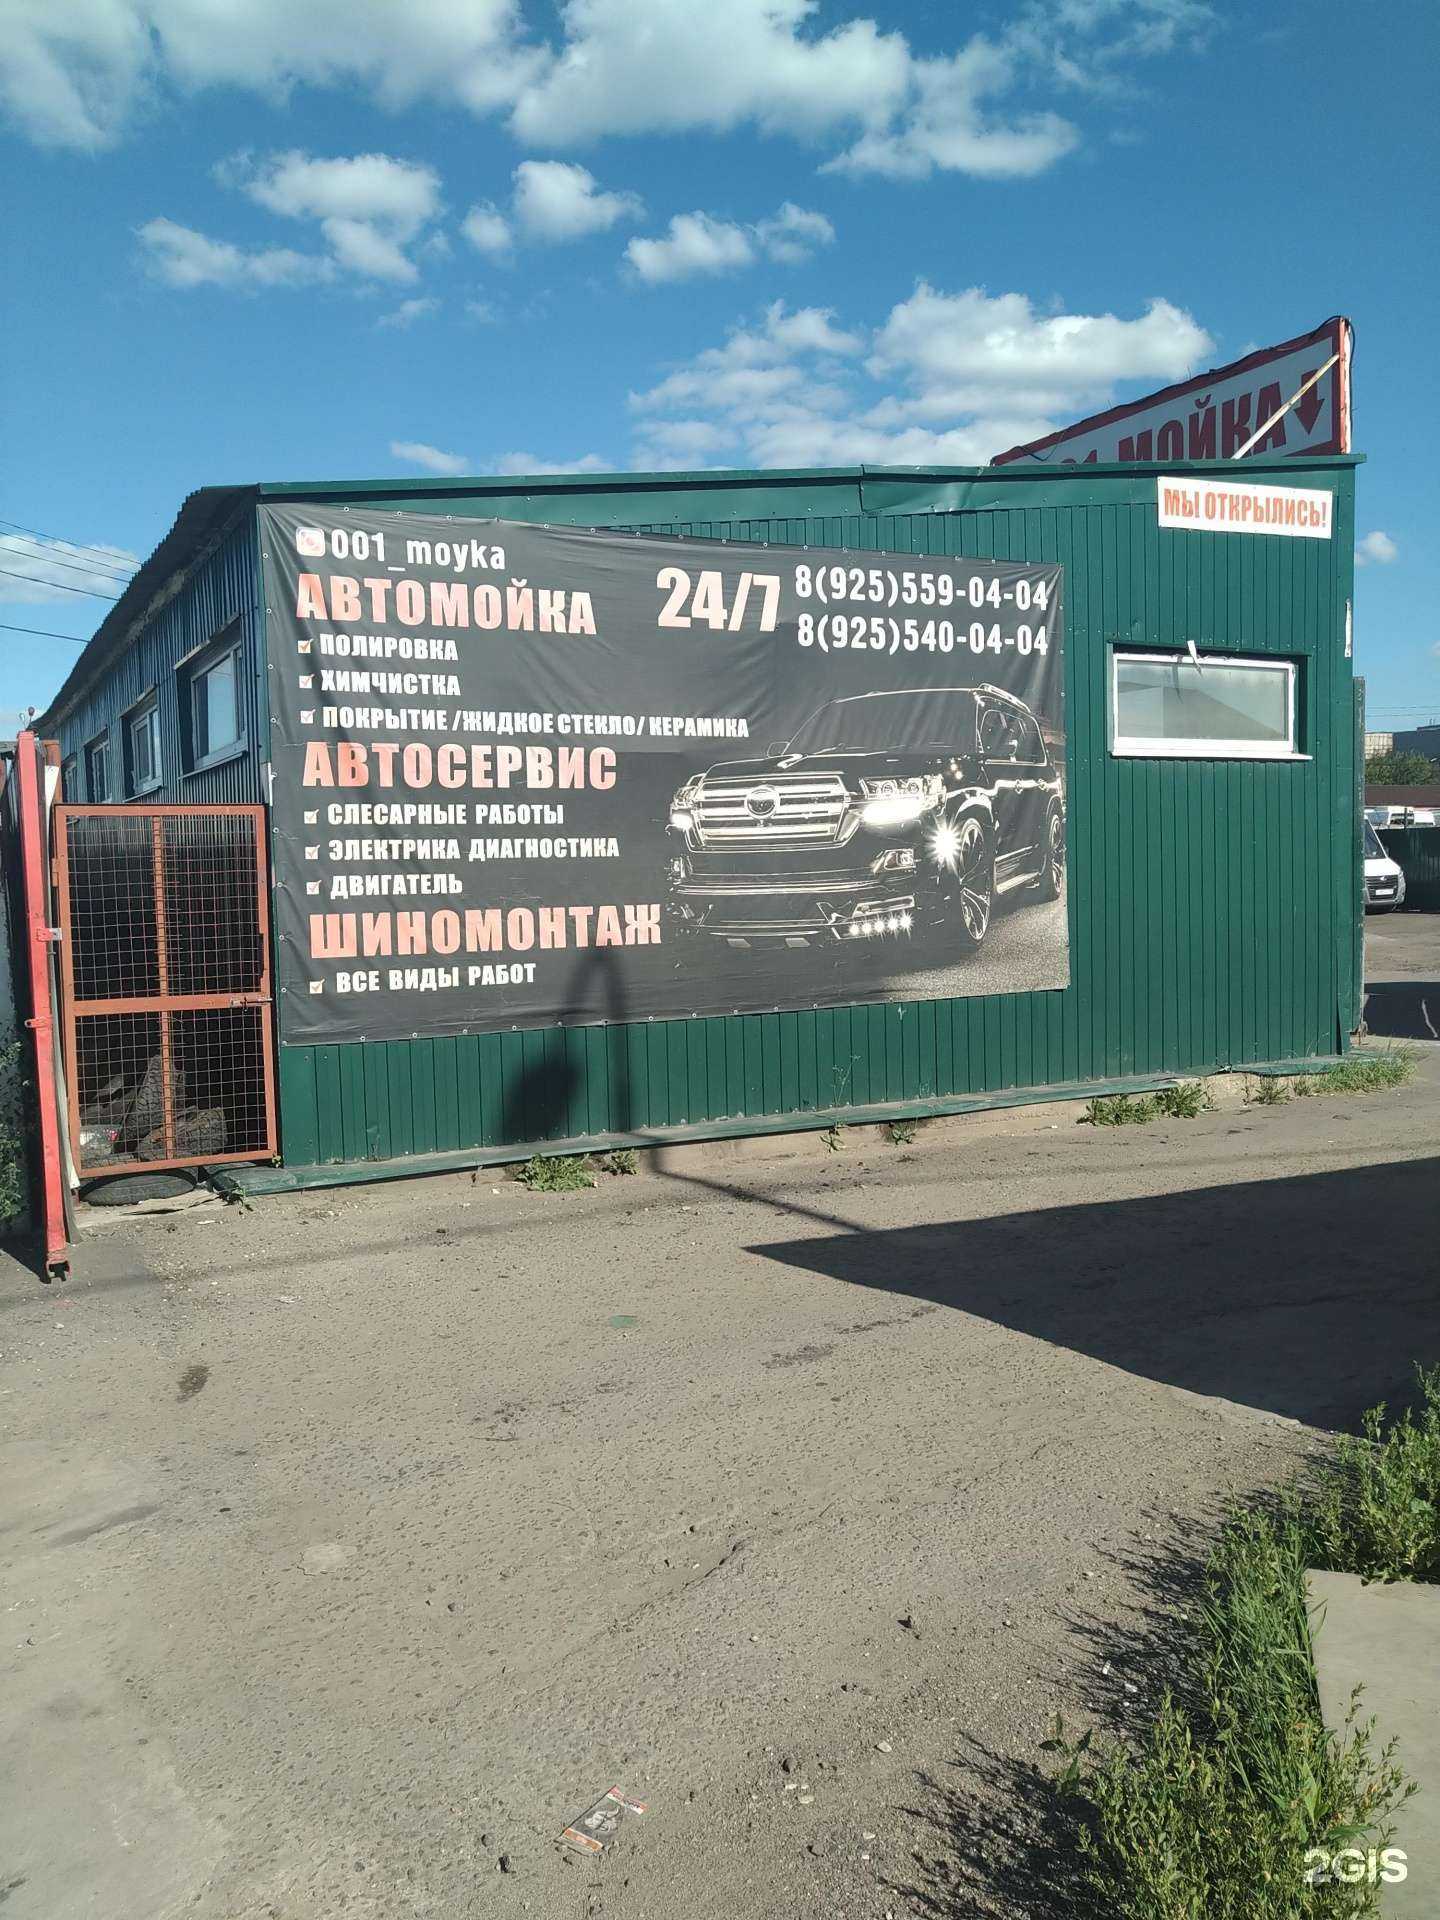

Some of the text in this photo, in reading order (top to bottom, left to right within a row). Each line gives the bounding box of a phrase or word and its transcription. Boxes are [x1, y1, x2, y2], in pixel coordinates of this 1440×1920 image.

[1118, 381, 1287, 462] МОЙКА
[1164, 488, 1327, 528] МЫ ОТКРЫЛИСЬ!
[331, 529, 506, 572] 001_moyka
[296, 573, 598, 635] АВТОМОЙКА
[656, 567, 781, 632] 24/7
[795, 565, 1049, 611] 8(925)559-04-04
[320, 633, 459, 661] ПОЛИРОВКА
[798, 613, 1049, 656] 8(925)540-04-04
[320, 669, 461, 696] ХИМЧИСТКА
[322, 706, 448, 732] ПОКРЫТИЕ
[649, 717, 750, 738] КЕРАМИКА
[302, 741, 618, 790] АВТОСЕРВИС
[327, 803, 564, 826] СЛЕСАРНЫЕ РАБОТЫ
[328, 837, 620, 862] ЭЛЕКТРИКА ДИАГНОСТИКА
[330, 873, 463, 899] ДВИГАТЕЛЬ
[309, 904, 662, 959] ШИНОМОНТАЖ
[336, 963, 537, 993] ВСЕ ВИДЫ РАБОТ
